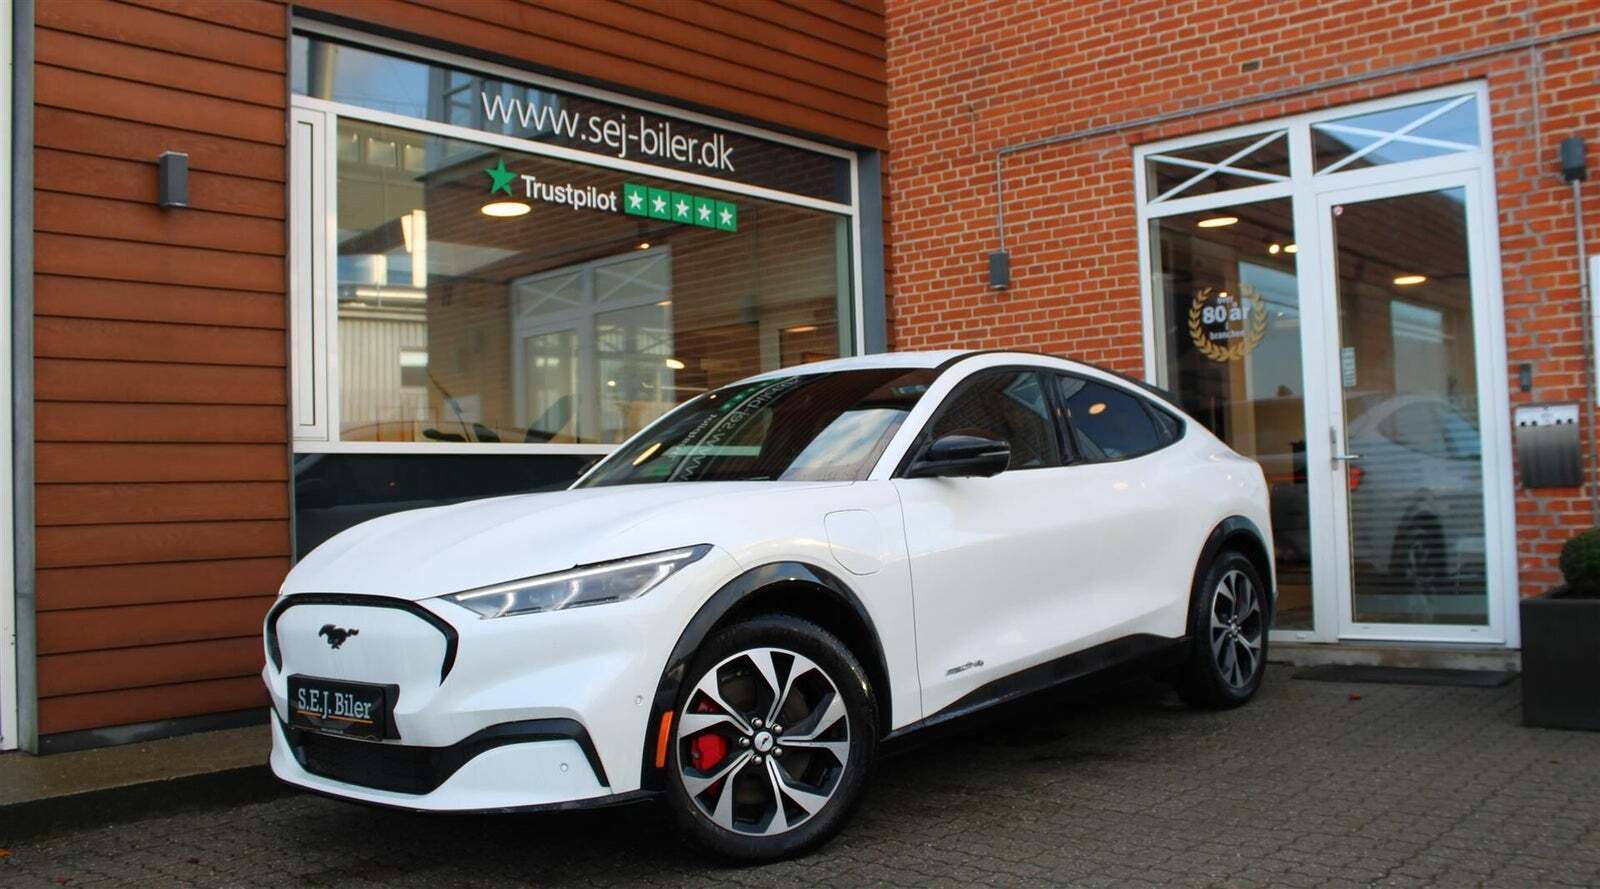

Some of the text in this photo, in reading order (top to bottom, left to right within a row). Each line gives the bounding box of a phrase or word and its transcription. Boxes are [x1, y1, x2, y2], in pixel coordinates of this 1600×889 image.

[481, 92, 735, 172] www.sej-biler.dk
[521, 174, 617, 212] Trustpilot
[1202, 302, 1251, 324] 80 år
[298, 687, 372, 719] S.E.J. Biler
